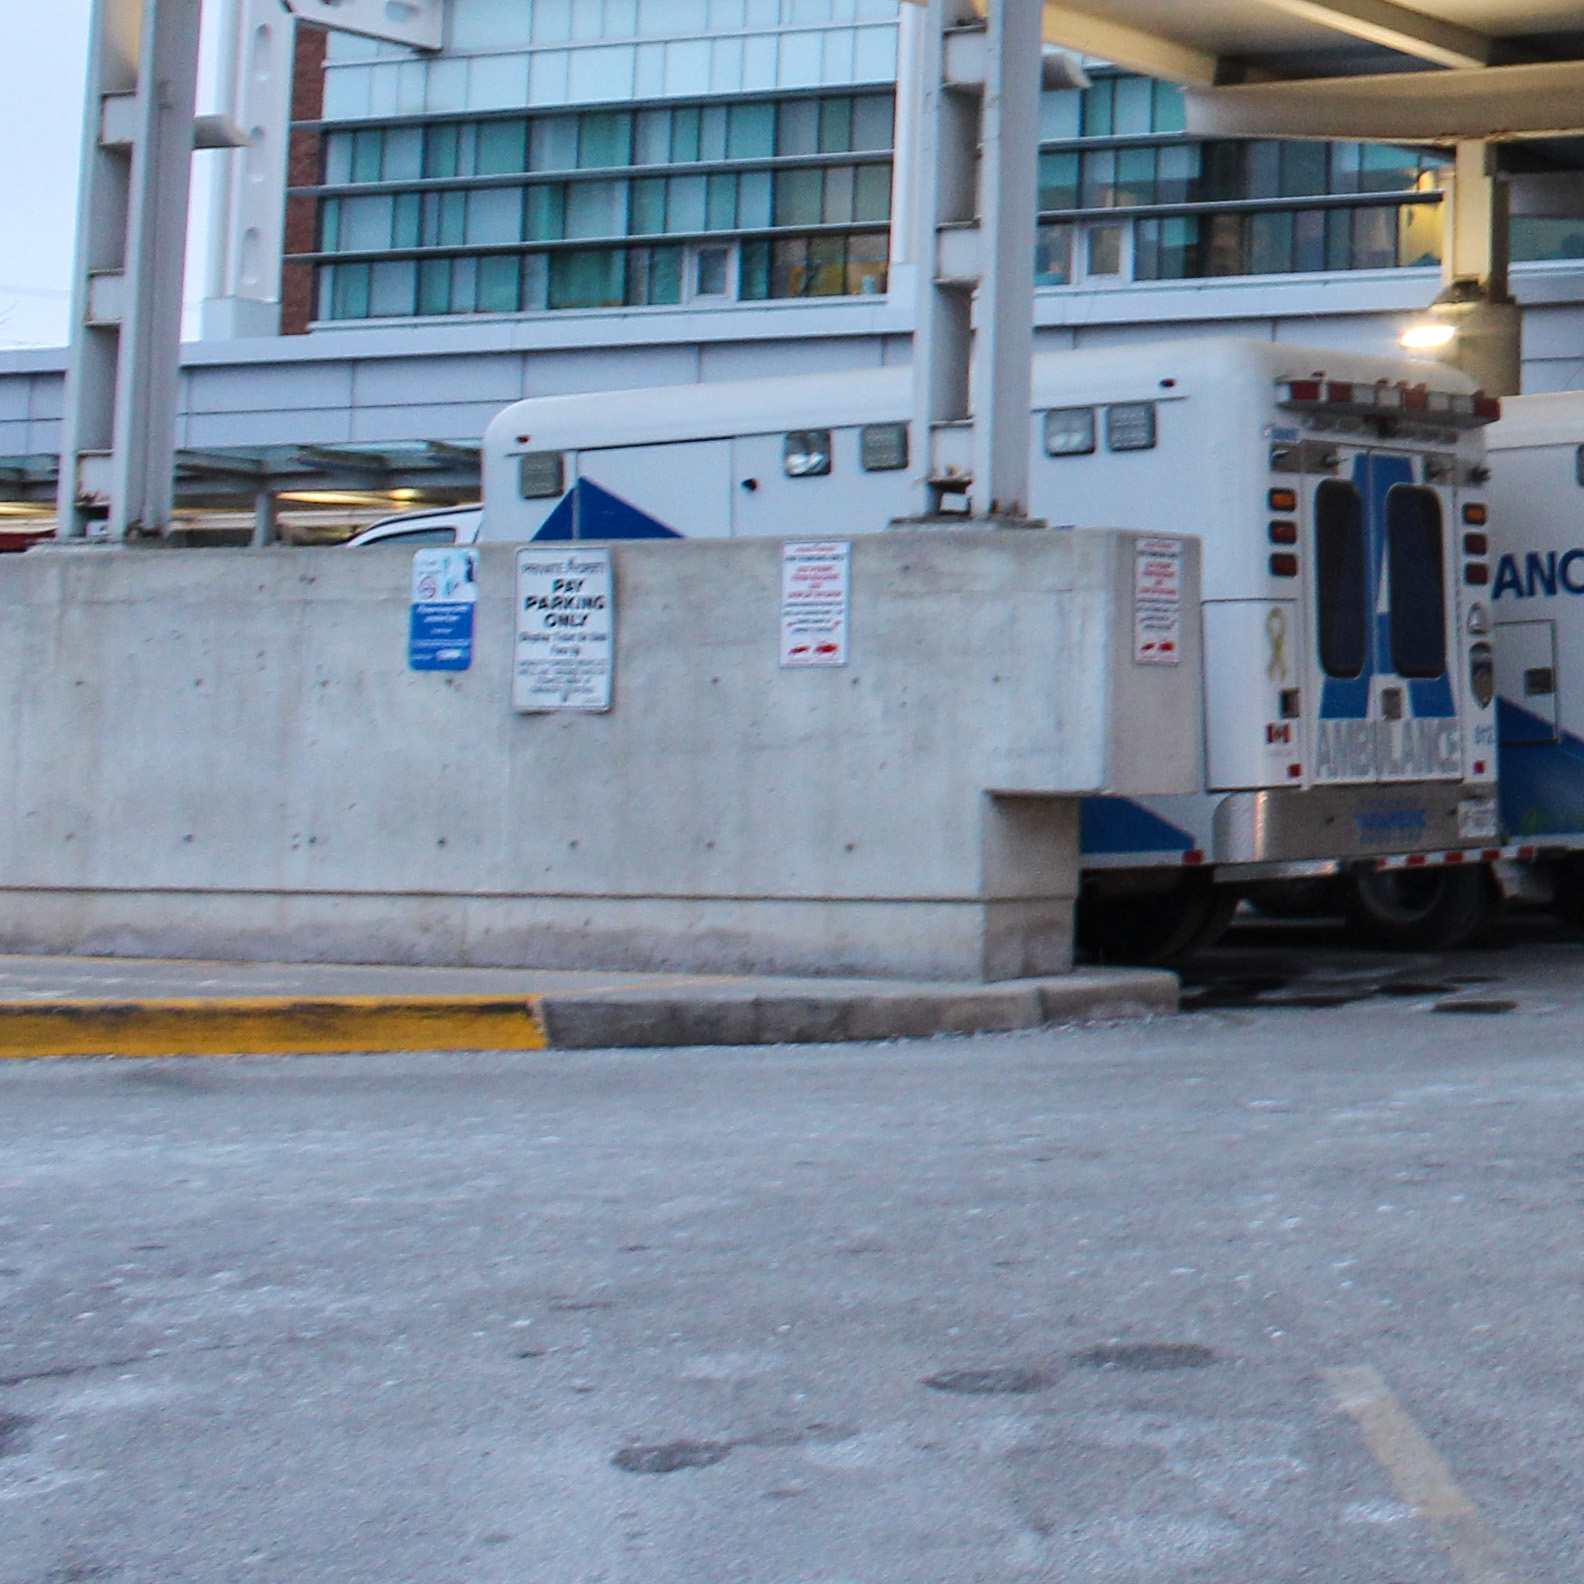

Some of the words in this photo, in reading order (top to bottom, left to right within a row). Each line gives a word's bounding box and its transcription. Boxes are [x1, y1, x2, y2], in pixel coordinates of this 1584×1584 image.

[553, 578, 586, 593] PAY
[524, 595, 606, 610] PARKING
[544, 613, 591, 628] ONLY
